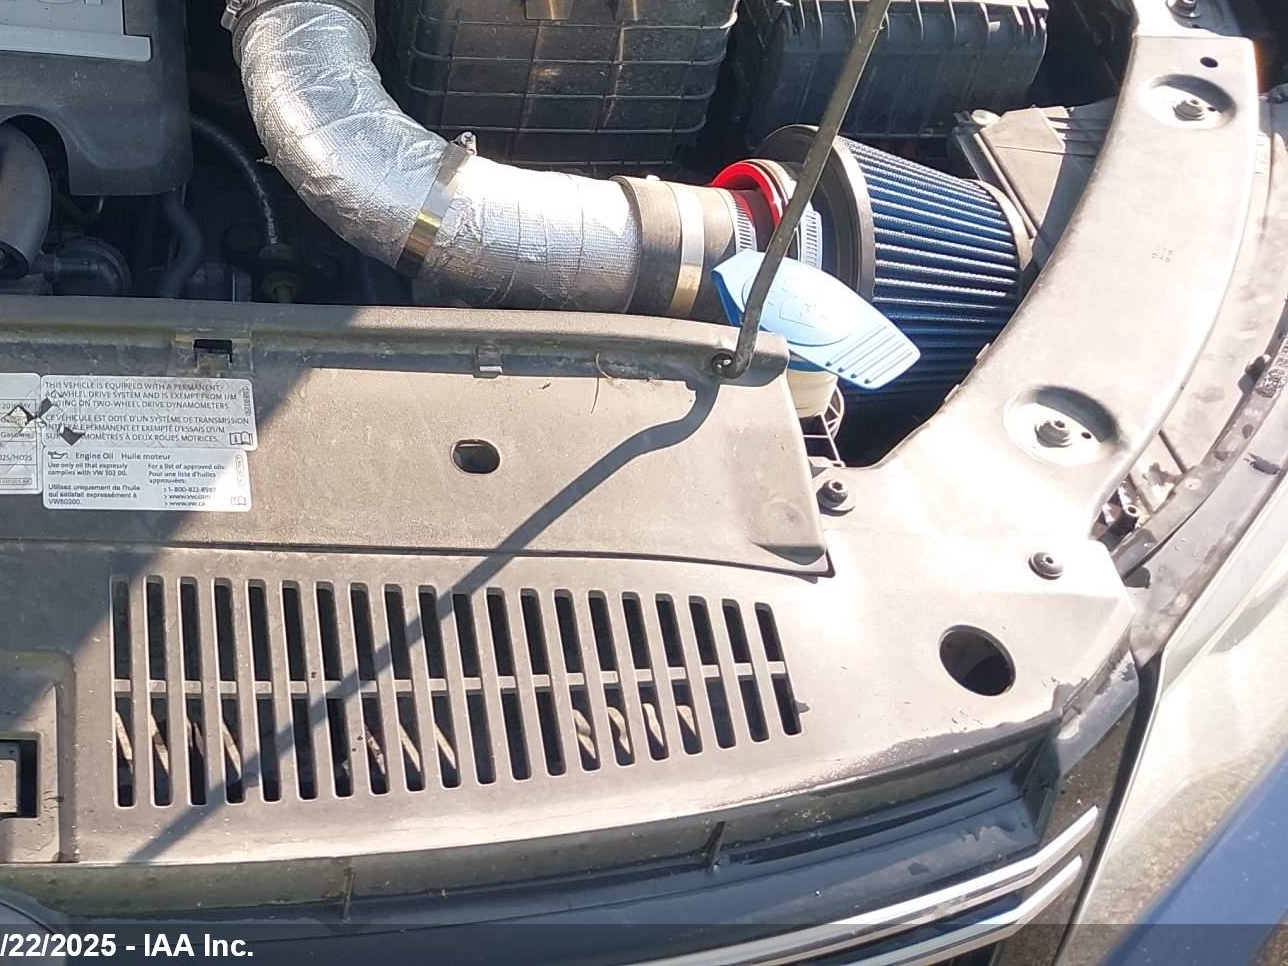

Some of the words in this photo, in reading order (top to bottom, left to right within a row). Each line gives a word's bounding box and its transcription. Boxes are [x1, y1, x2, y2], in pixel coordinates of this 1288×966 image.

[194, 416, 249, 424] TRANSMISSION
[132, 433, 152, 441] DEUX
[75, 452, 101, 461] Engine
[61, 462, 74, 470] only
[99, 463, 128, 471] expressly
